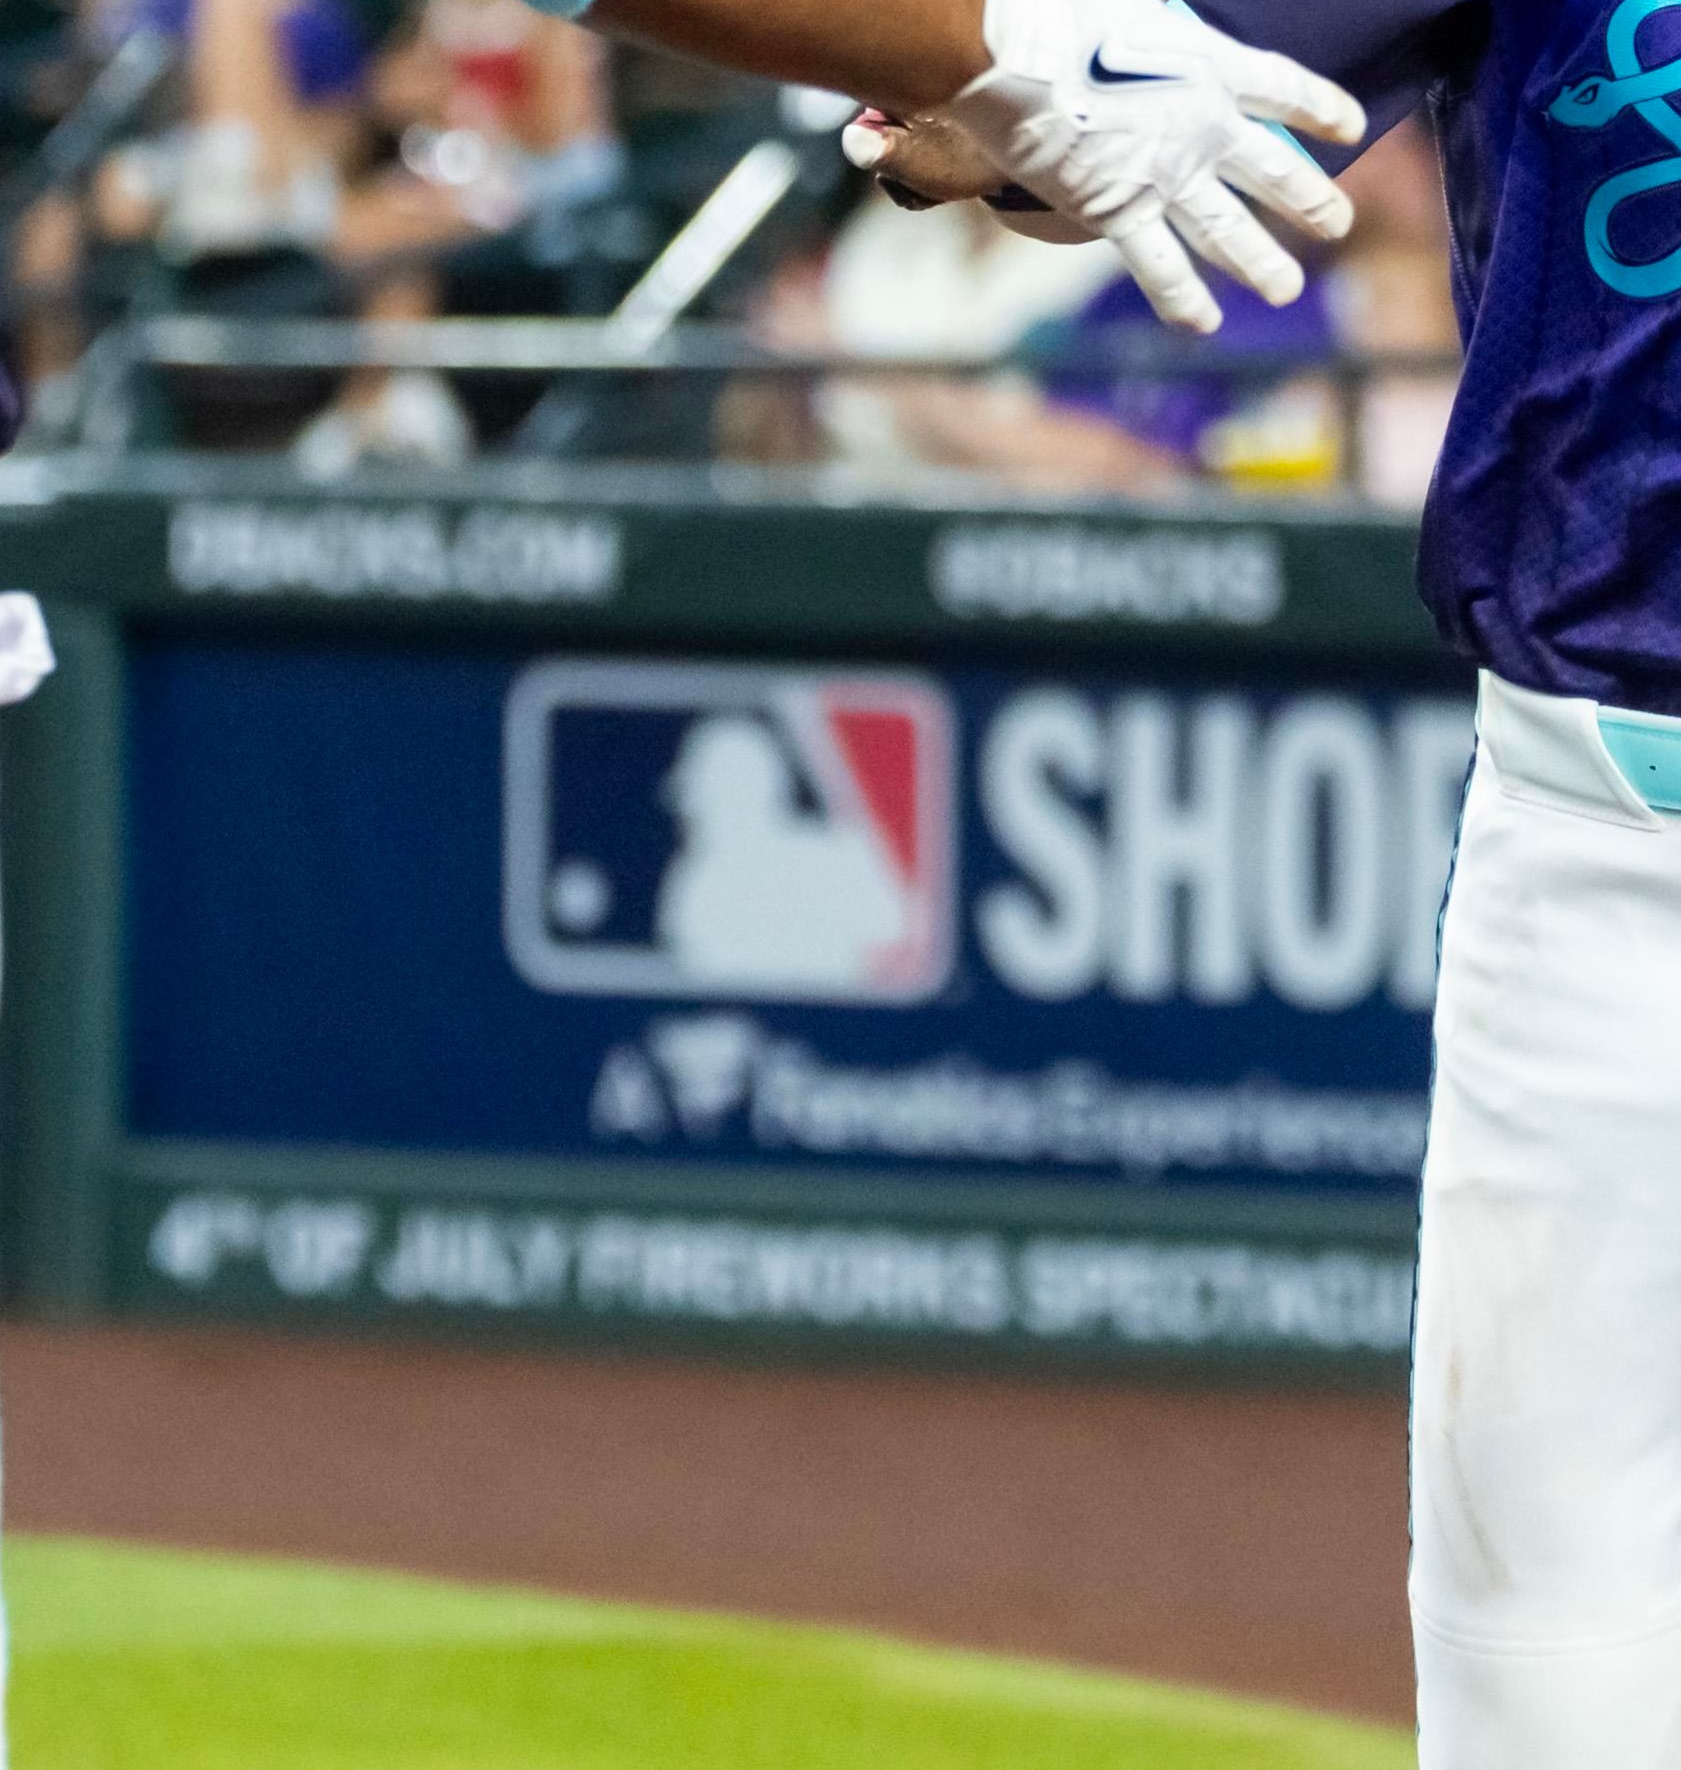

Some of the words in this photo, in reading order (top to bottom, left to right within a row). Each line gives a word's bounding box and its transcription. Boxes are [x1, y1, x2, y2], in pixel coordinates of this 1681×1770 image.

[266, 1197, 366, 1299] OF
[376, 1207, 571, 1308] JULY
[576, 1214, 1009, 1334] FIREWORKS
